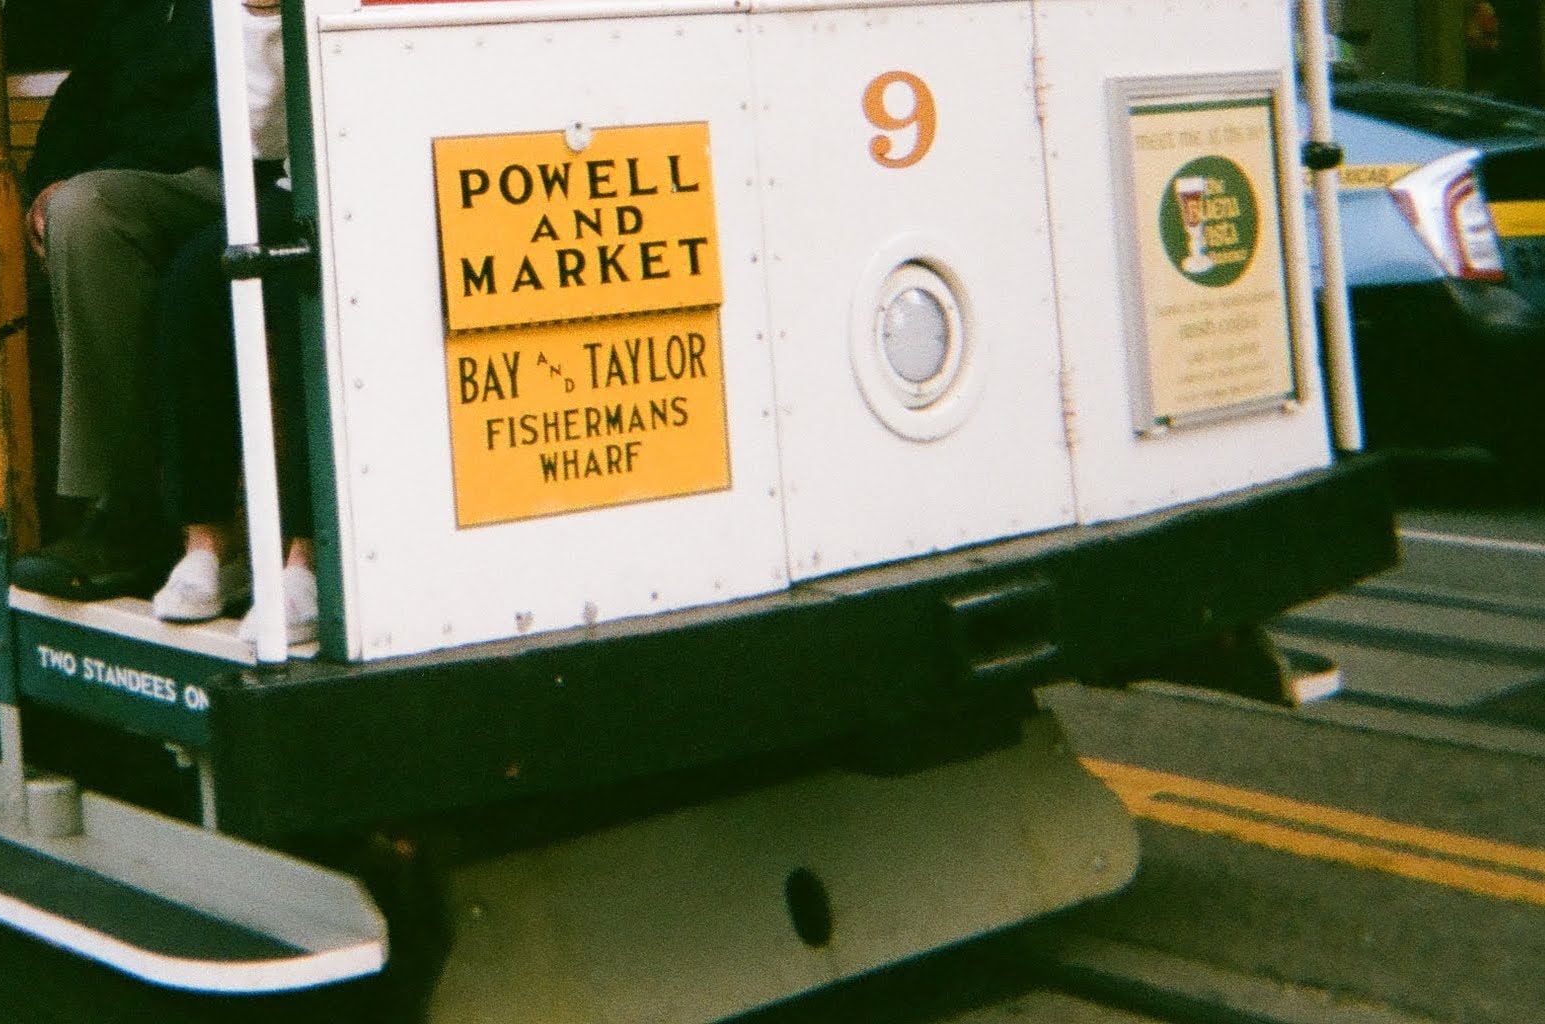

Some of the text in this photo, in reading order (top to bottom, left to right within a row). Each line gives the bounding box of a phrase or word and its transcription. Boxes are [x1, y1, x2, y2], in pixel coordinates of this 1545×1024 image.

[862, 70, 937, 169] 9
[459, 155, 699, 209] POWELL
[530, 205, 644, 243] AND
[461, 237, 708, 297] MARKET
[458, 332, 707, 404] BAY AND TAYLOR
[486, 397, 688, 450] FISHERMANS
[540, 441, 642, 484] WHARF
[37, 645, 77, 676] TWO
[82, 657, 177, 703] STANDEES
